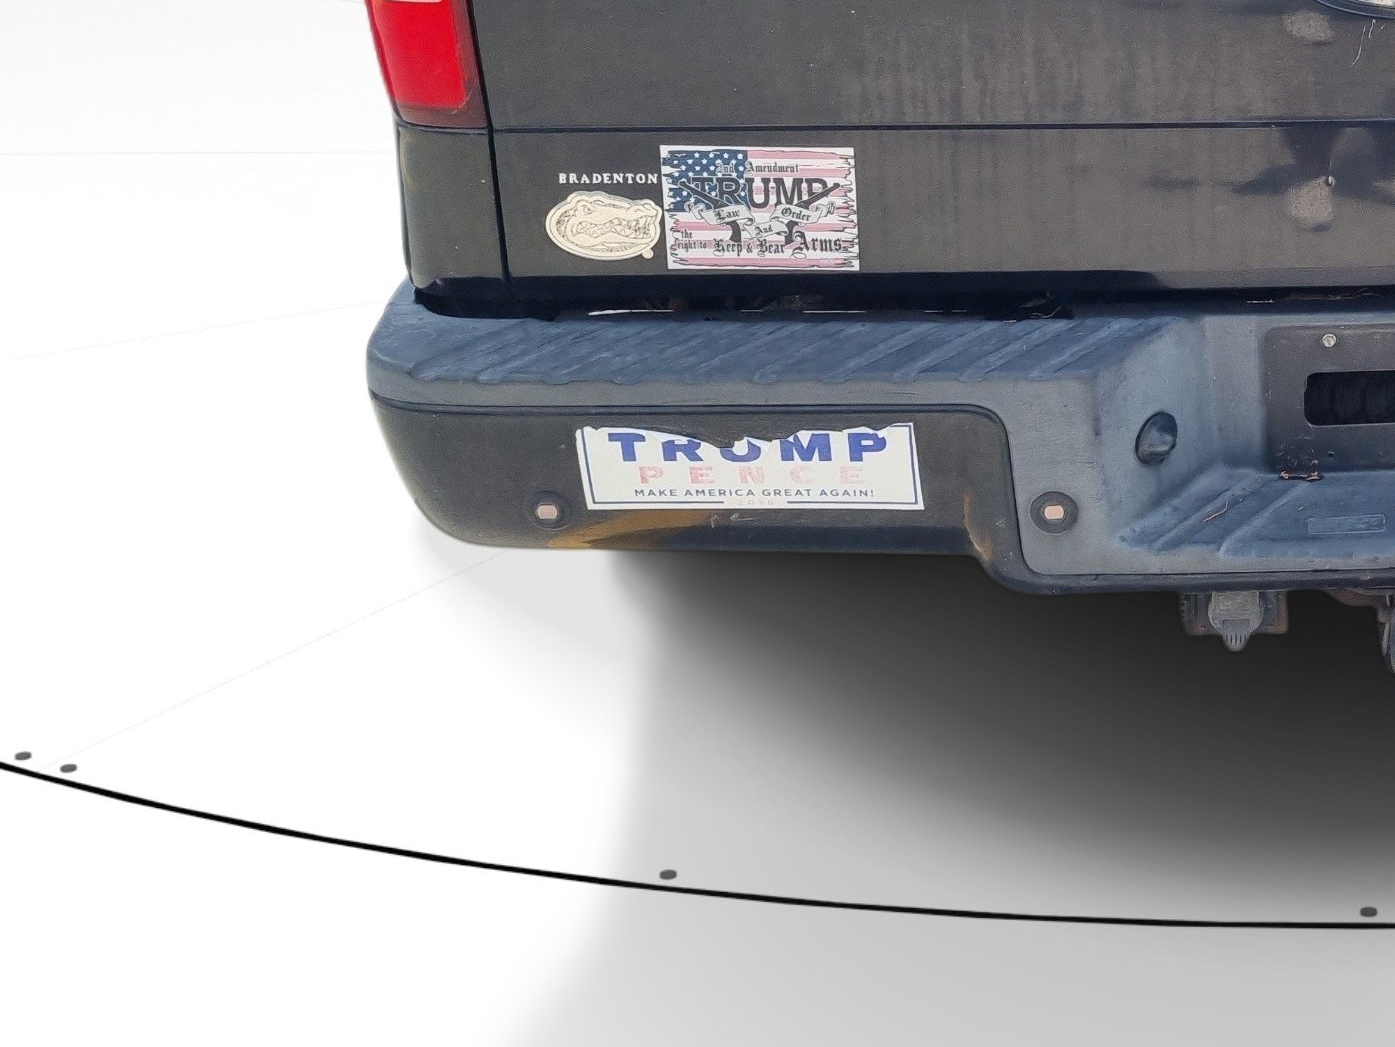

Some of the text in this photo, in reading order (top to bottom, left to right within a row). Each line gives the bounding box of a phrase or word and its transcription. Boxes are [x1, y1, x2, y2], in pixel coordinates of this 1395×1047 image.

[715, 160, 800, 175] 2nd Amendment
[559, 172, 658, 184] BRADENTON
[691, 176, 829, 209] TRUMP
[713, 206, 811, 222] Law Order
[681, 229, 692, 239] the
[755, 226, 774, 238] And
[677, 240, 696, 252] right
[700, 241, 707, 249] to
[713, 238, 743, 257] Keep
[747, 242, 753, 254] &
[757, 238, 786, 256] Bear
[638, 465, 864, 485] PENCE
[634, 488, 875, 497] MAKE AMERICA GREAT AGAIN!
